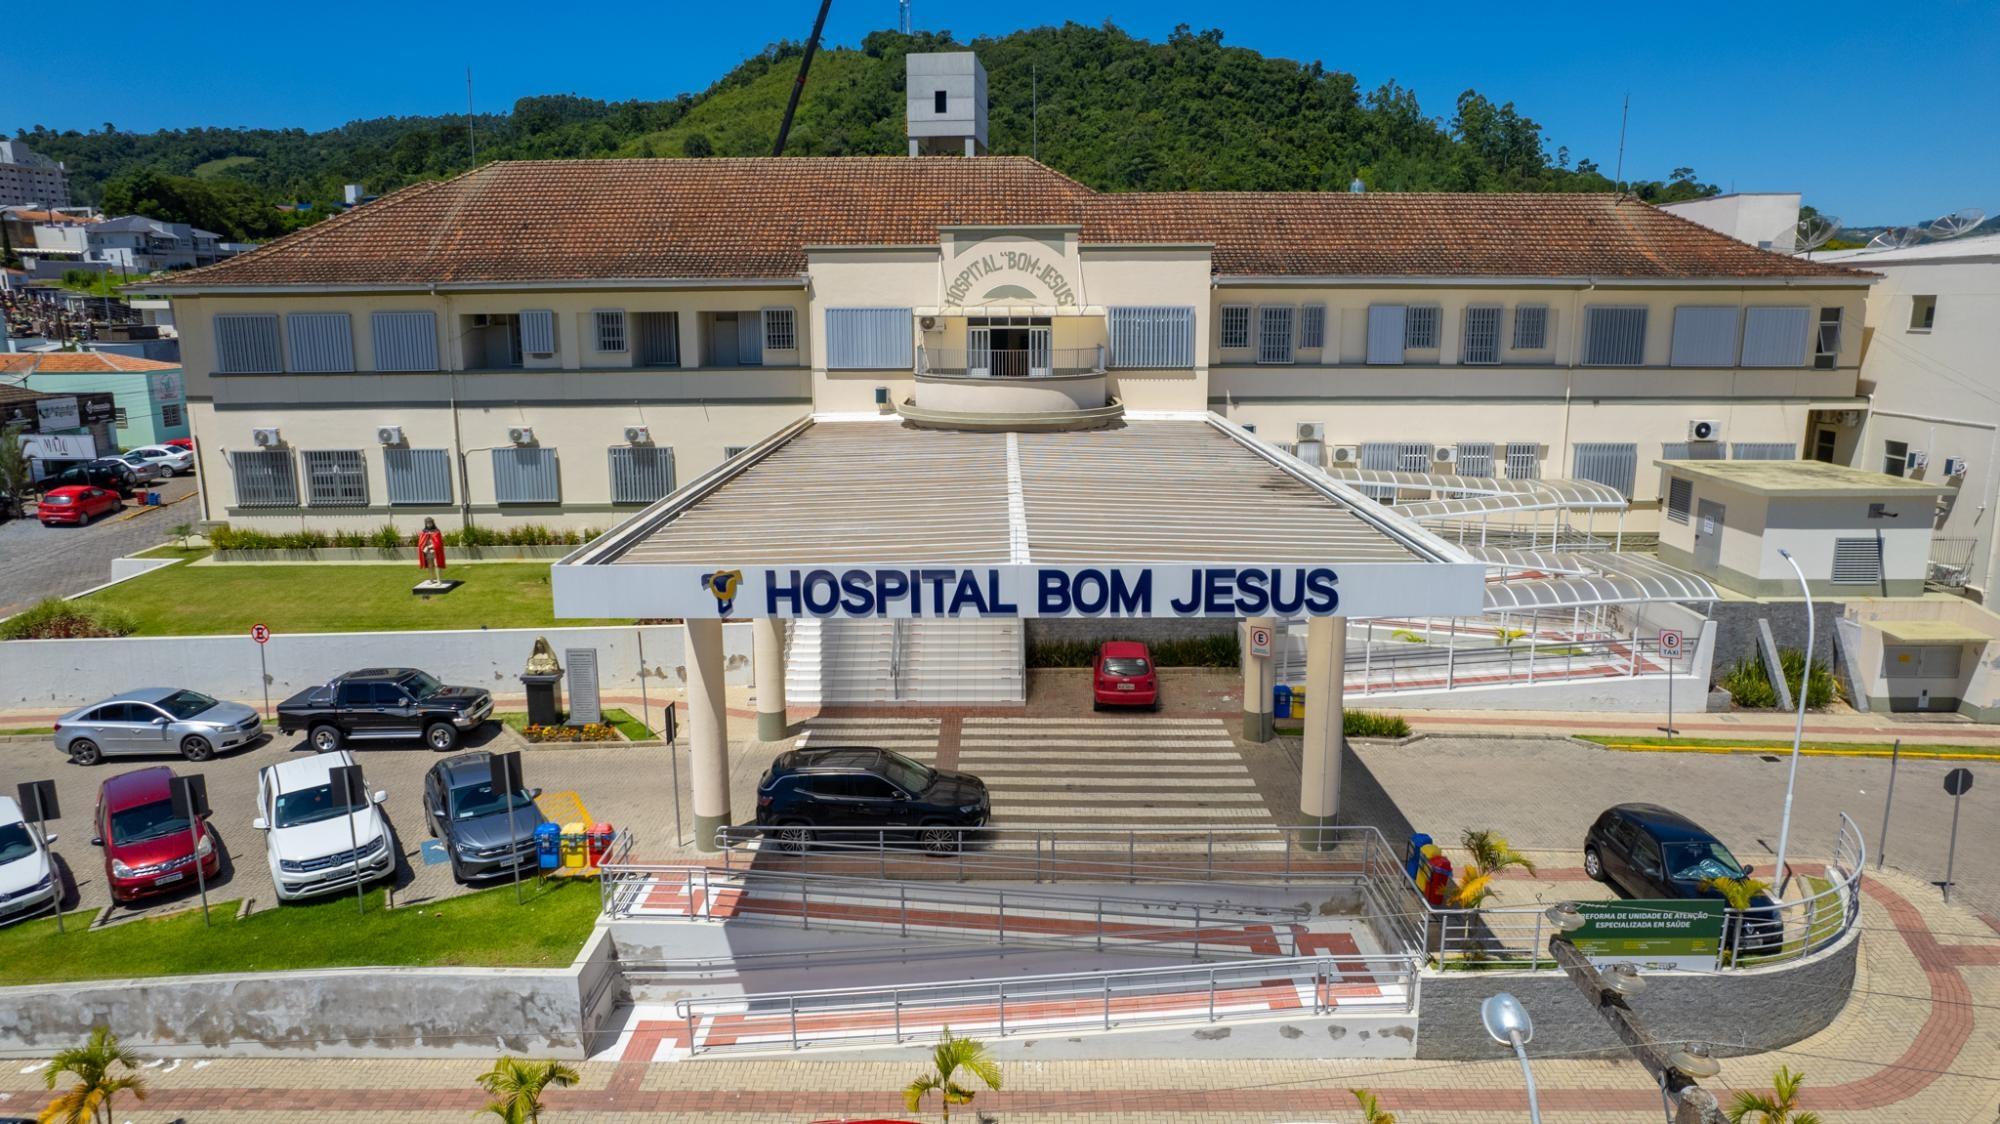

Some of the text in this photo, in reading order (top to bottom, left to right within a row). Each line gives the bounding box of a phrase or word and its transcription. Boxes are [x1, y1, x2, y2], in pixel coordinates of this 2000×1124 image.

[944, 254, 1003, 307] HOSPITAL
[765, 568, 1339, 617] HOSPITAL BOM JESUS
[1258, 633, 1264, 643] E
[1668, 636, 1674, 645] E
[1581, 911, 1708, 921] REFORMA DE UNIDADE DE ATENÇÃO
[1595, 921, 1691, 929] ESPECIALIZADA EM SAÚDE
